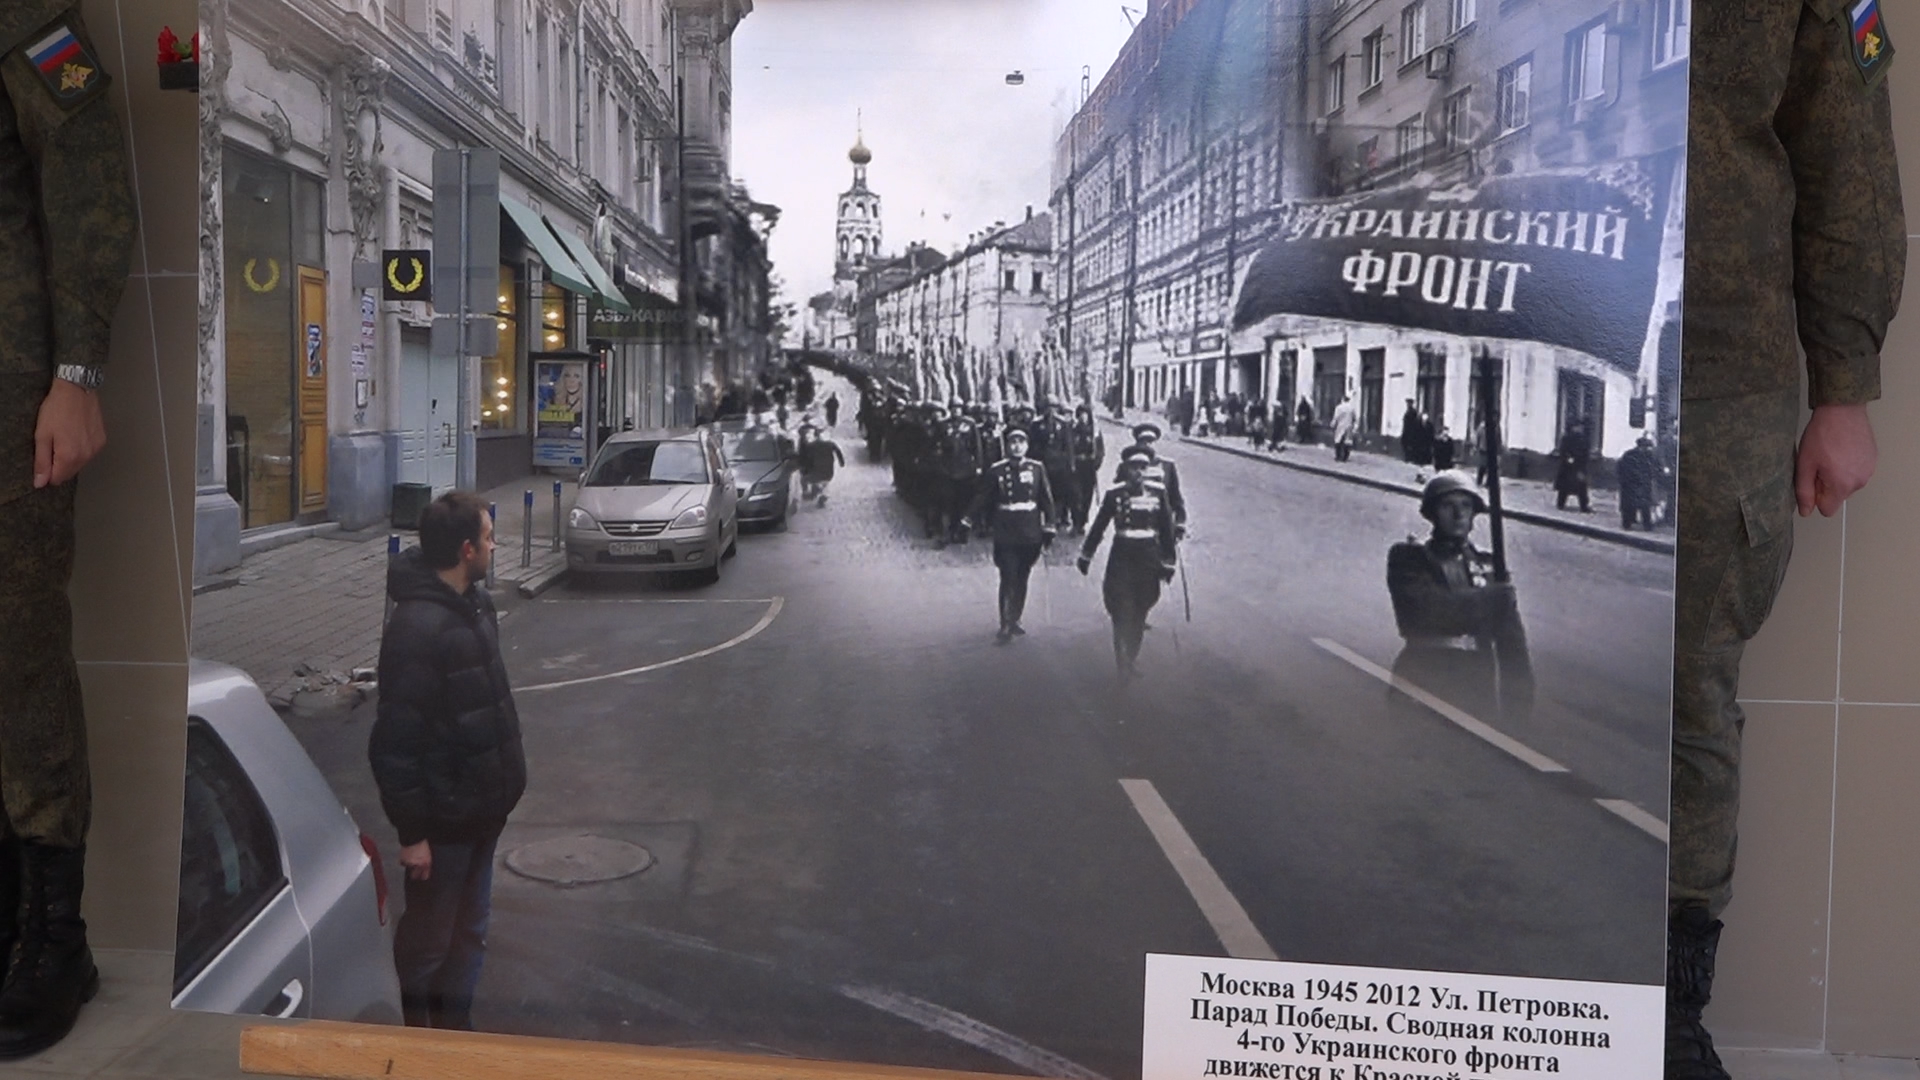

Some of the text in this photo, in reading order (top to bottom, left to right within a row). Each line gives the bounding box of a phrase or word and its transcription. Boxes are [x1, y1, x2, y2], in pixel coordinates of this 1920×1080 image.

[1341, 248, 1532, 312] ФРОНТ
[1200, 972, 1610, 1021] Москва 1945 2012 Ул. Петровка.
[1190, 998, 1611, 1049] Парад Победы. Сводная колонна
[1203, 1059, 1321, 1080] движется
[1237, 1028, 1560, 1073] 4-го Украинского фронта
